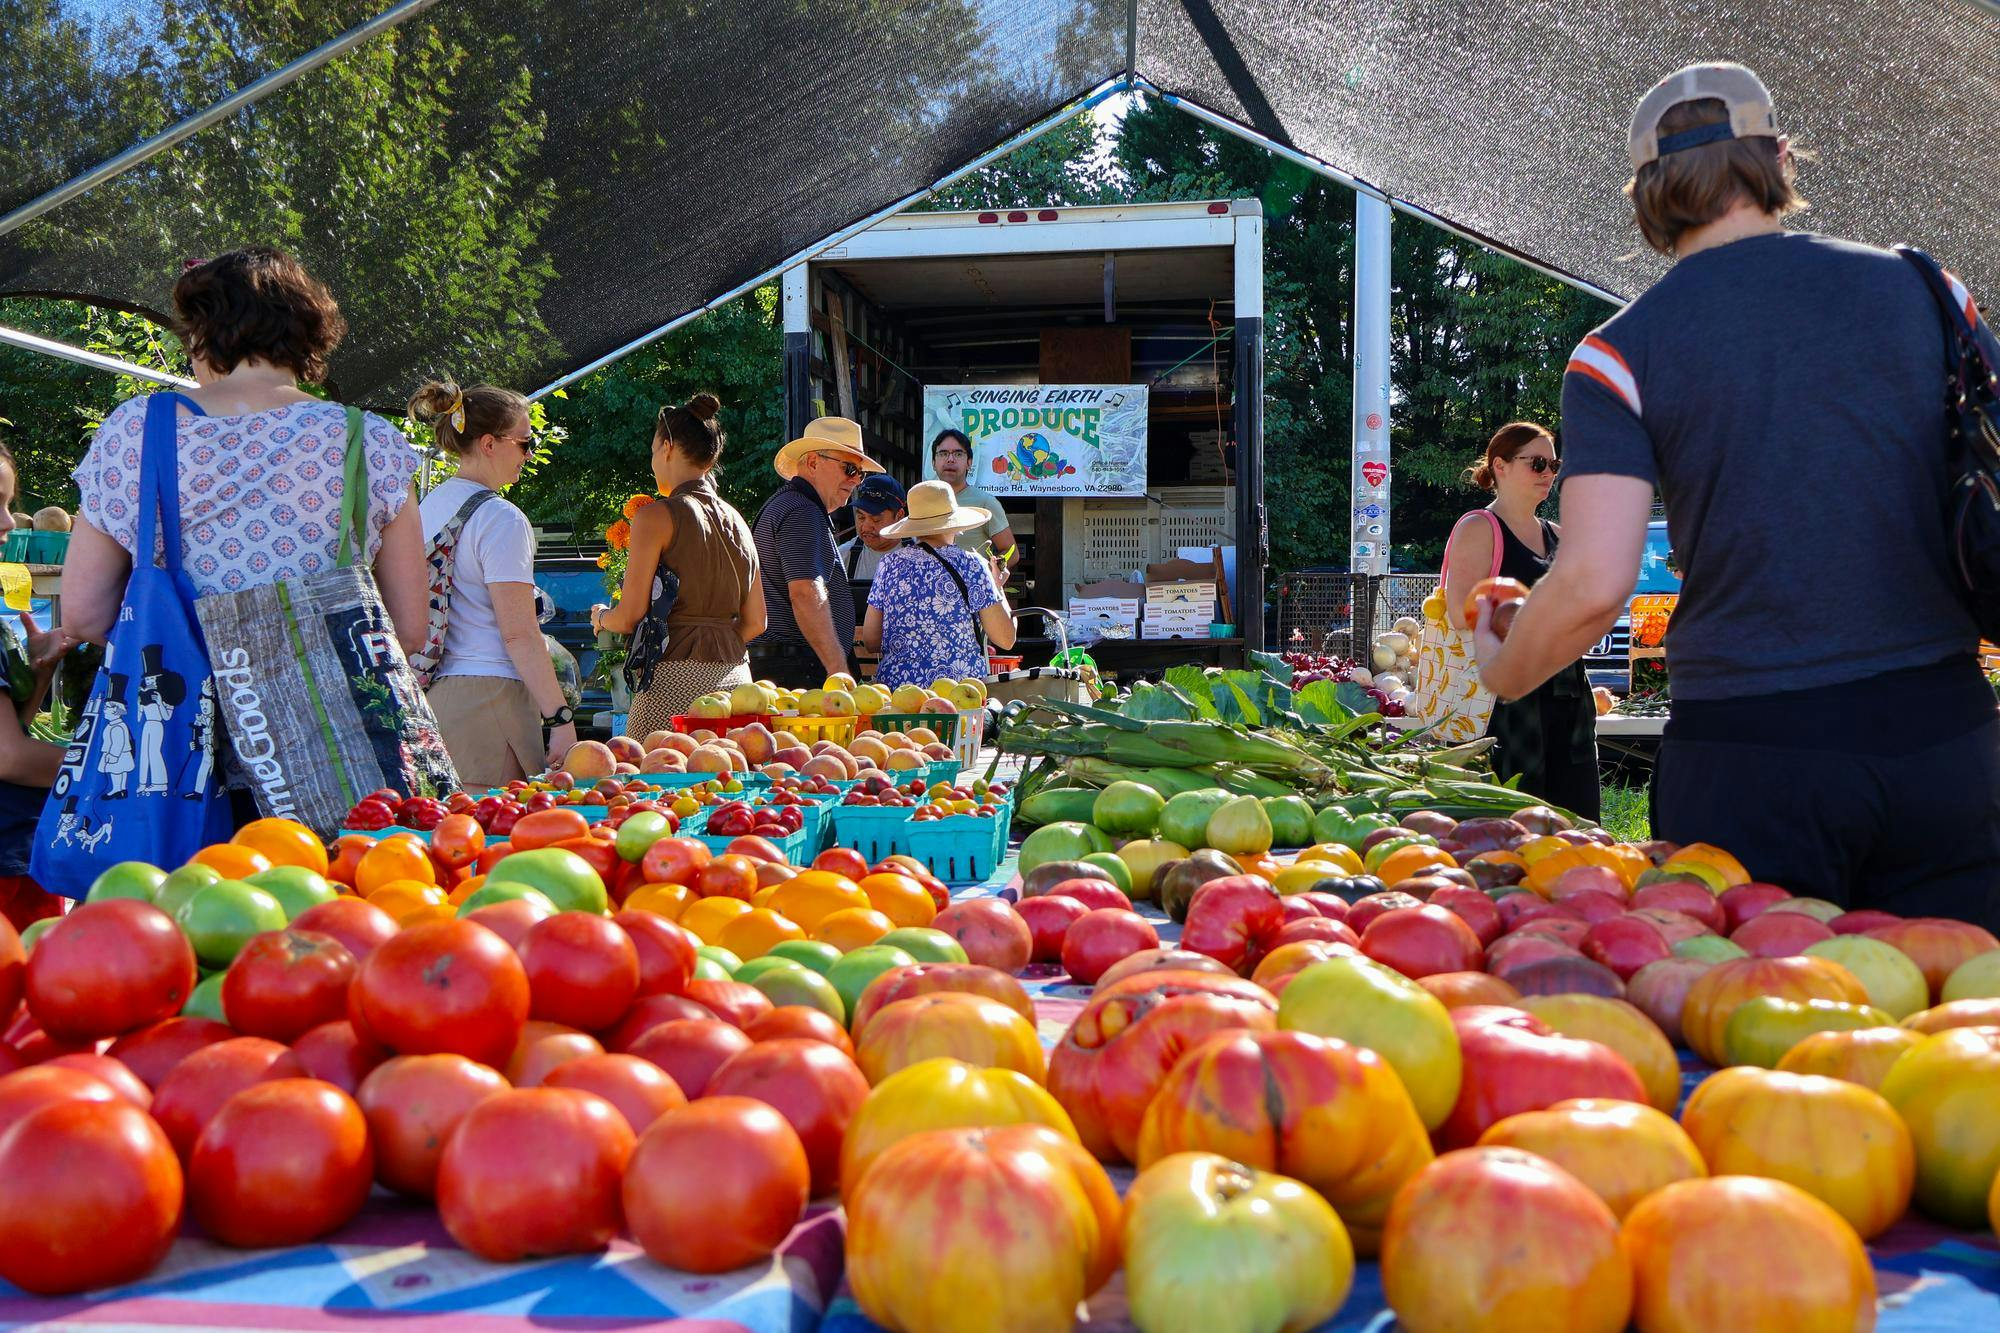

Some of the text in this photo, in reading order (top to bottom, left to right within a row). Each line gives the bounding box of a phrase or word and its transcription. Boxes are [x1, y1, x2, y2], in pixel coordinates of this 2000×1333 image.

[968, 389, 1104, 404] SINGING EARTH
[961, 407, 1101, 450] PRODUCE
[978, 485, 1009, 493] rmitage
[1029, 484, 1082, 493] Waynesboro,
[1084, 484, 1096, 492] VA
[1097, 484, 1123, 492] 22980
[119, 606, 134, 622] ER
[213, 647, 304, 825] meGoods
